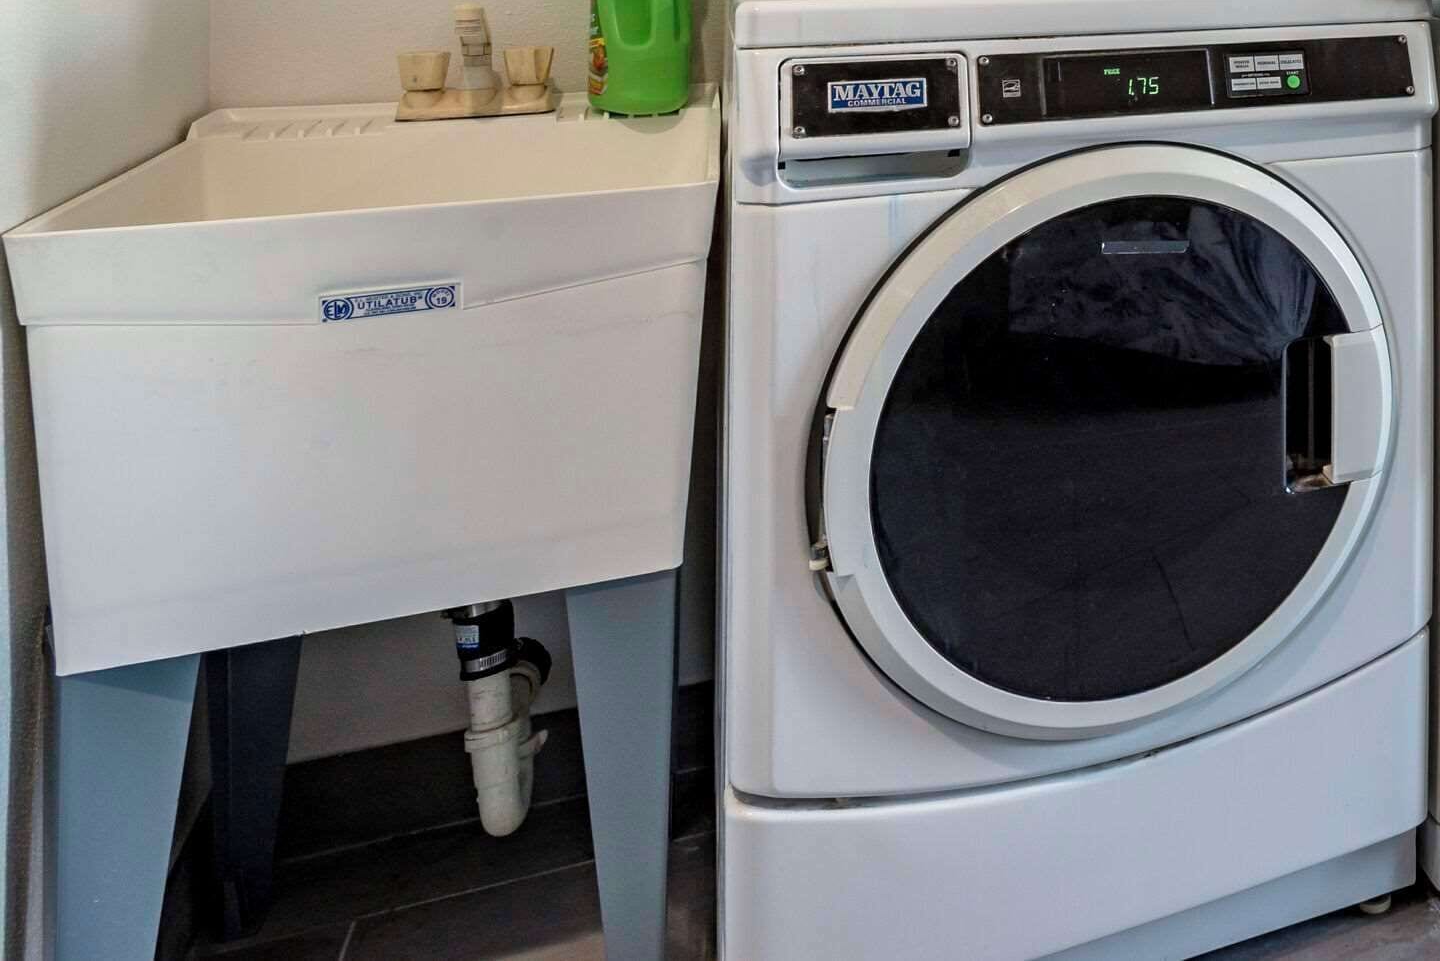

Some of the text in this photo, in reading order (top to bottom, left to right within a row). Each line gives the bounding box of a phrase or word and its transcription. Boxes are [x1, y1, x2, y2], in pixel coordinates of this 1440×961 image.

[833, 82, 922, 102] MAYTAG
[1128, 76, 1159, 96] 1.75
[847, 98, 907, 108] COMMERCIAL
[357, 295, 418, 310] UTILATUB
[436, 296, 448, 305] 19
